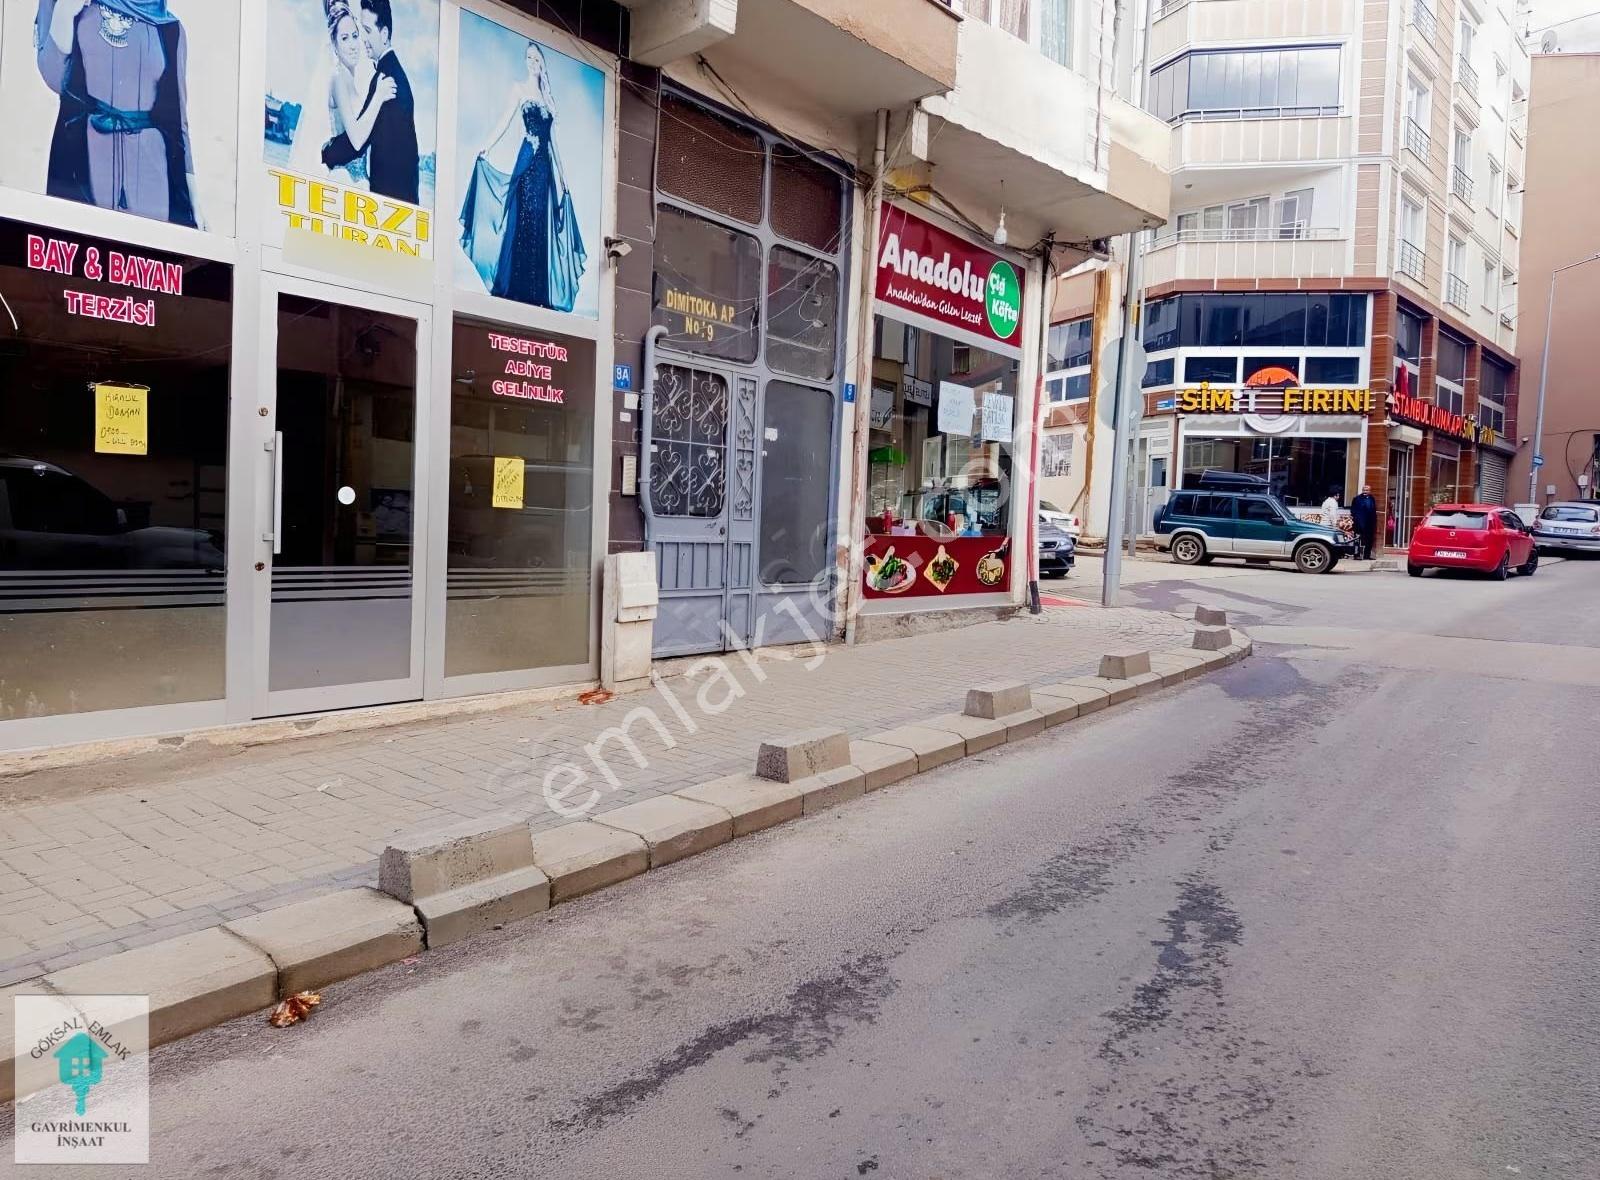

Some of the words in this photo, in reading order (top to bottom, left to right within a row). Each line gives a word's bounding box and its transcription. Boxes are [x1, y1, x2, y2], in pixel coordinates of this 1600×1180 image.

[268, 169, 429, 242] TERZİ
[27, 234, 79, 276] BAY
[84, 247, 103, 281] &
[109, 251, 182, 295] BAYAN
[879, 233, 985, 302] Anadolu
[63, 290, 156, 326] TERZİSİ
[666, 287, 718, 320] DİMİTOKA
[721, 304, 735, 323] AP
[886, 282, 938, 310] Anadolu'dan
[939, 300, 960, 318] Gelen
[992, 298, 1017, 323] Köfte
[488, 333, 568, 362] TESETTÜR
[504, 360, 552, 380] ABİYE
[492, 380, 563, 404] GELİNLİK
[1283, 388, 1370, 412] FIRINI
